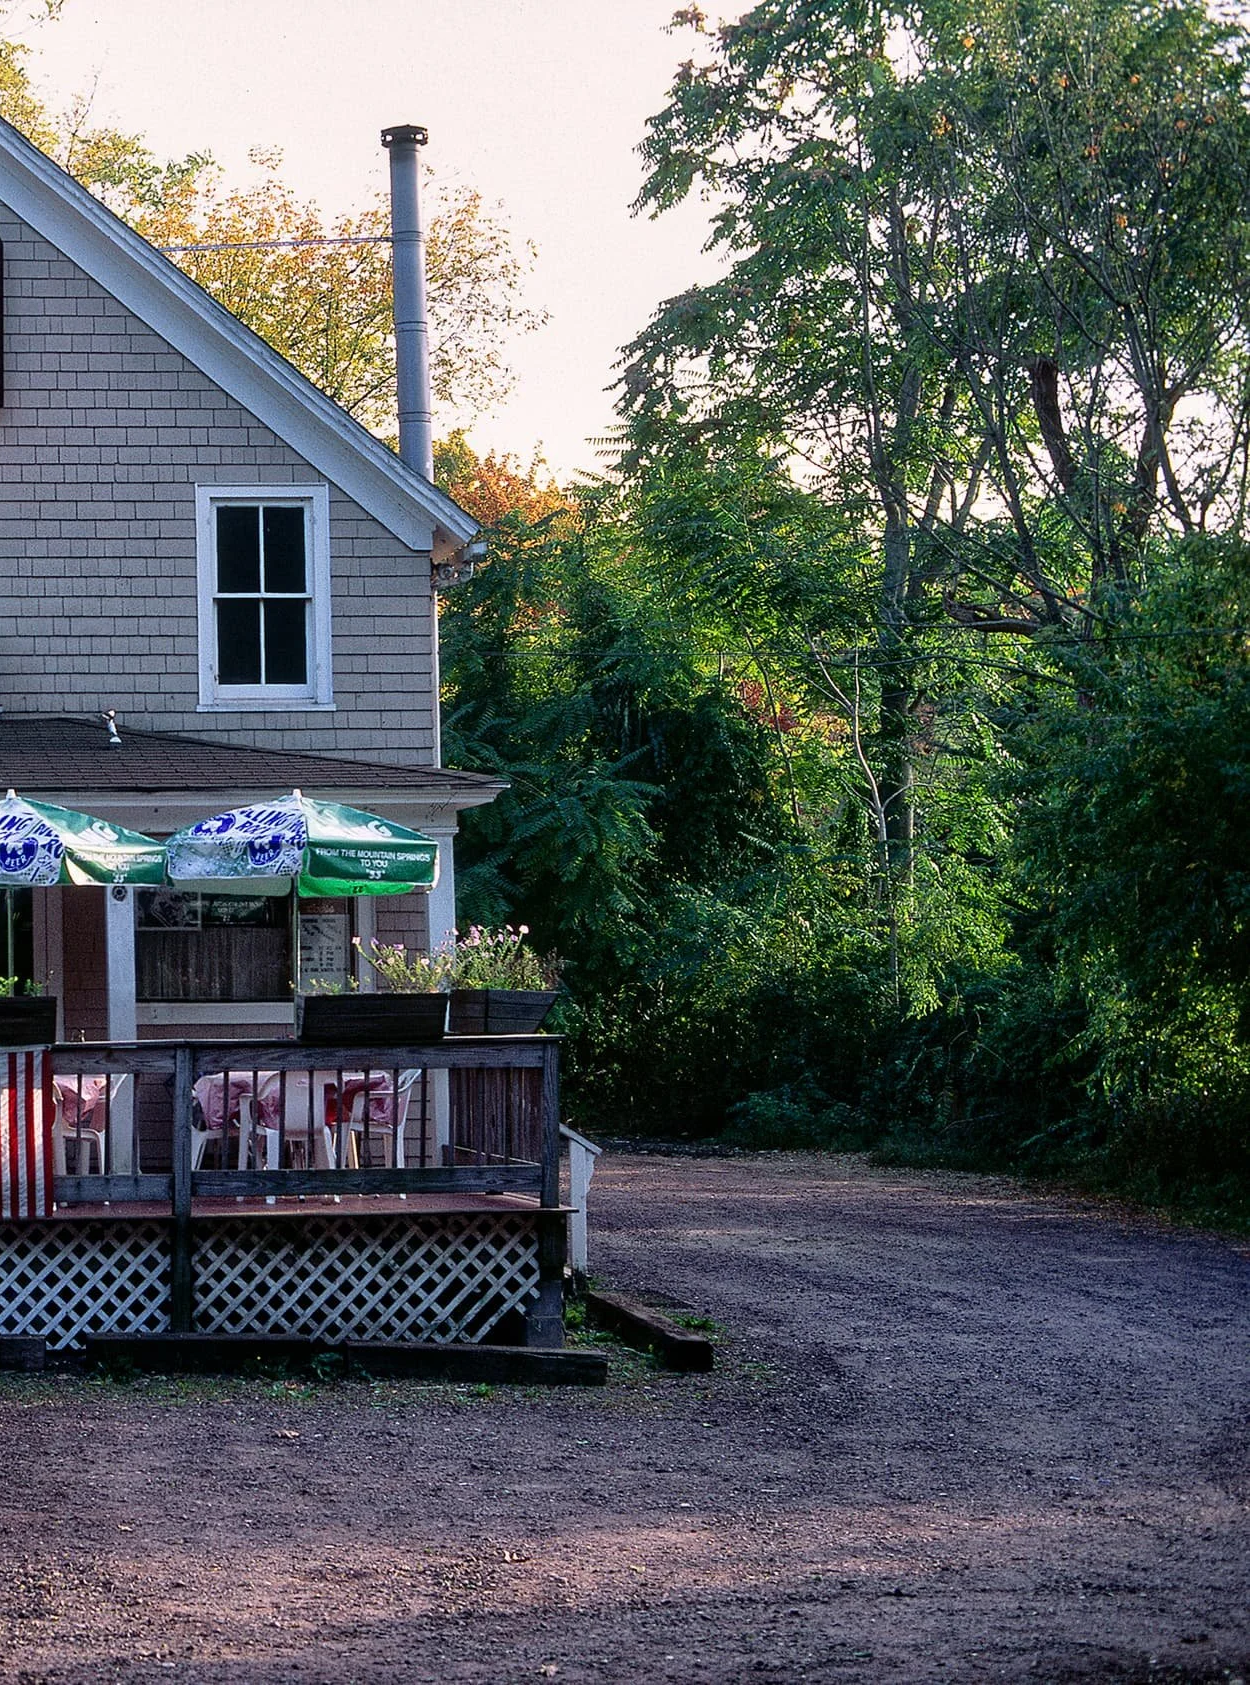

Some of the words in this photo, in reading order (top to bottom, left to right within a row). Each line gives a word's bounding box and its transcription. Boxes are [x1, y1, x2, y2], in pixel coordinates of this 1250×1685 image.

[316, 847, 339, 857] FROM
[341, 849, 357, 858] THE
[357, 850, 396, 860] MOUNTAIN
[397, 852, 431, 862] SPRINGS
[4, 855, 27, 868] BEER
[360, 858, 371, 867] TO
[372, 859, 389, 868] YOU
